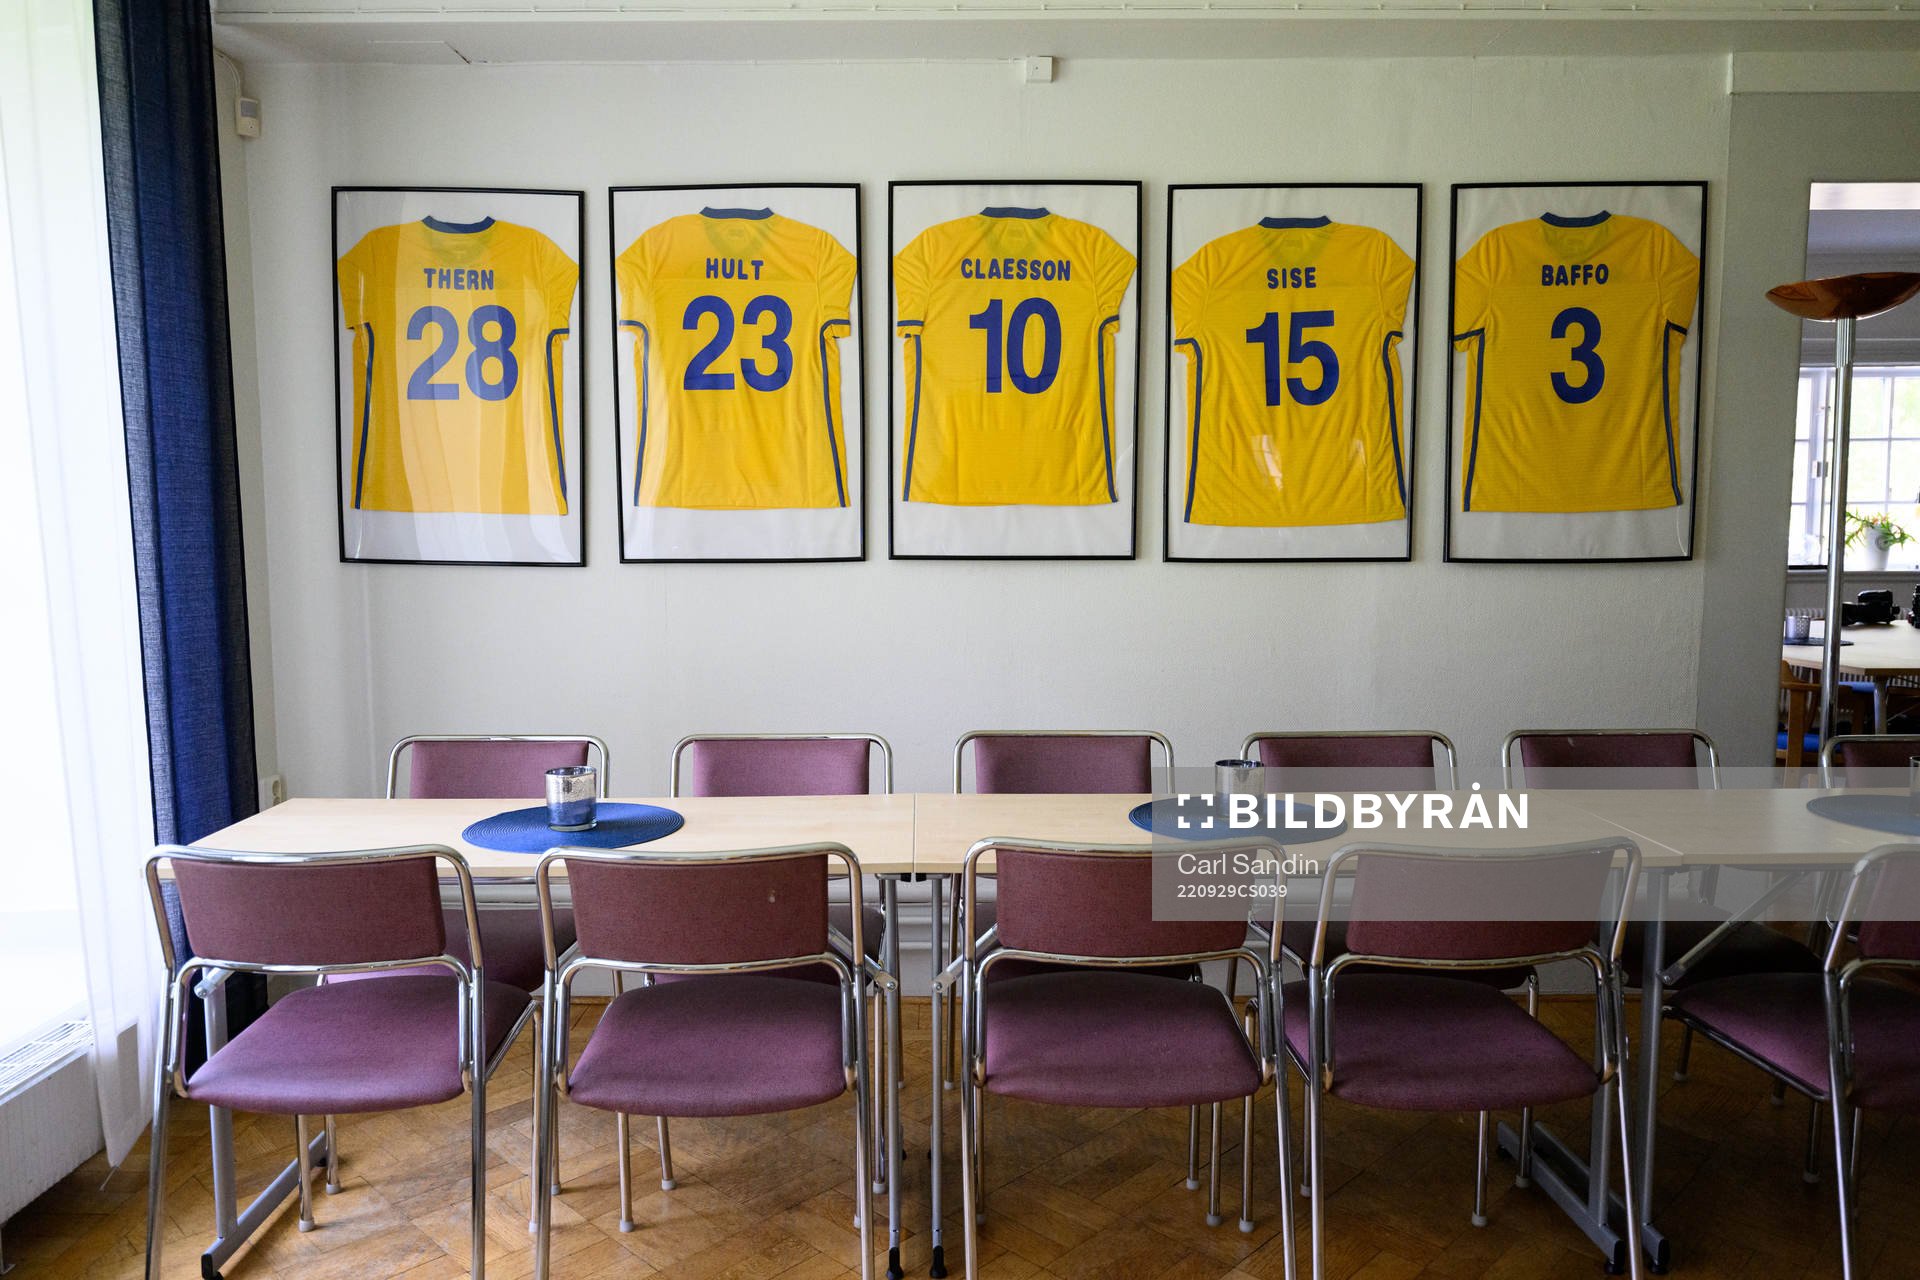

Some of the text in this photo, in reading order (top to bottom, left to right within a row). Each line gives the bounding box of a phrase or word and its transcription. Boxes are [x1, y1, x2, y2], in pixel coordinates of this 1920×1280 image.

[424, 268, 494, 291] THERN
[705, 258, 764, 280] HULT
[961, 258, 1071, 281] CLAESSON
[1267, 267, 1316, 289] SISE
[1542, 264, 1609, 286] BAFFO
[406, 305, 519, 401] 28
[683, 295, 793, 392] 23
[969, 297, 1061, 395] 10
[1246, 310, 1340, 406] 15
[1551, 307, 1605, 404] 3
